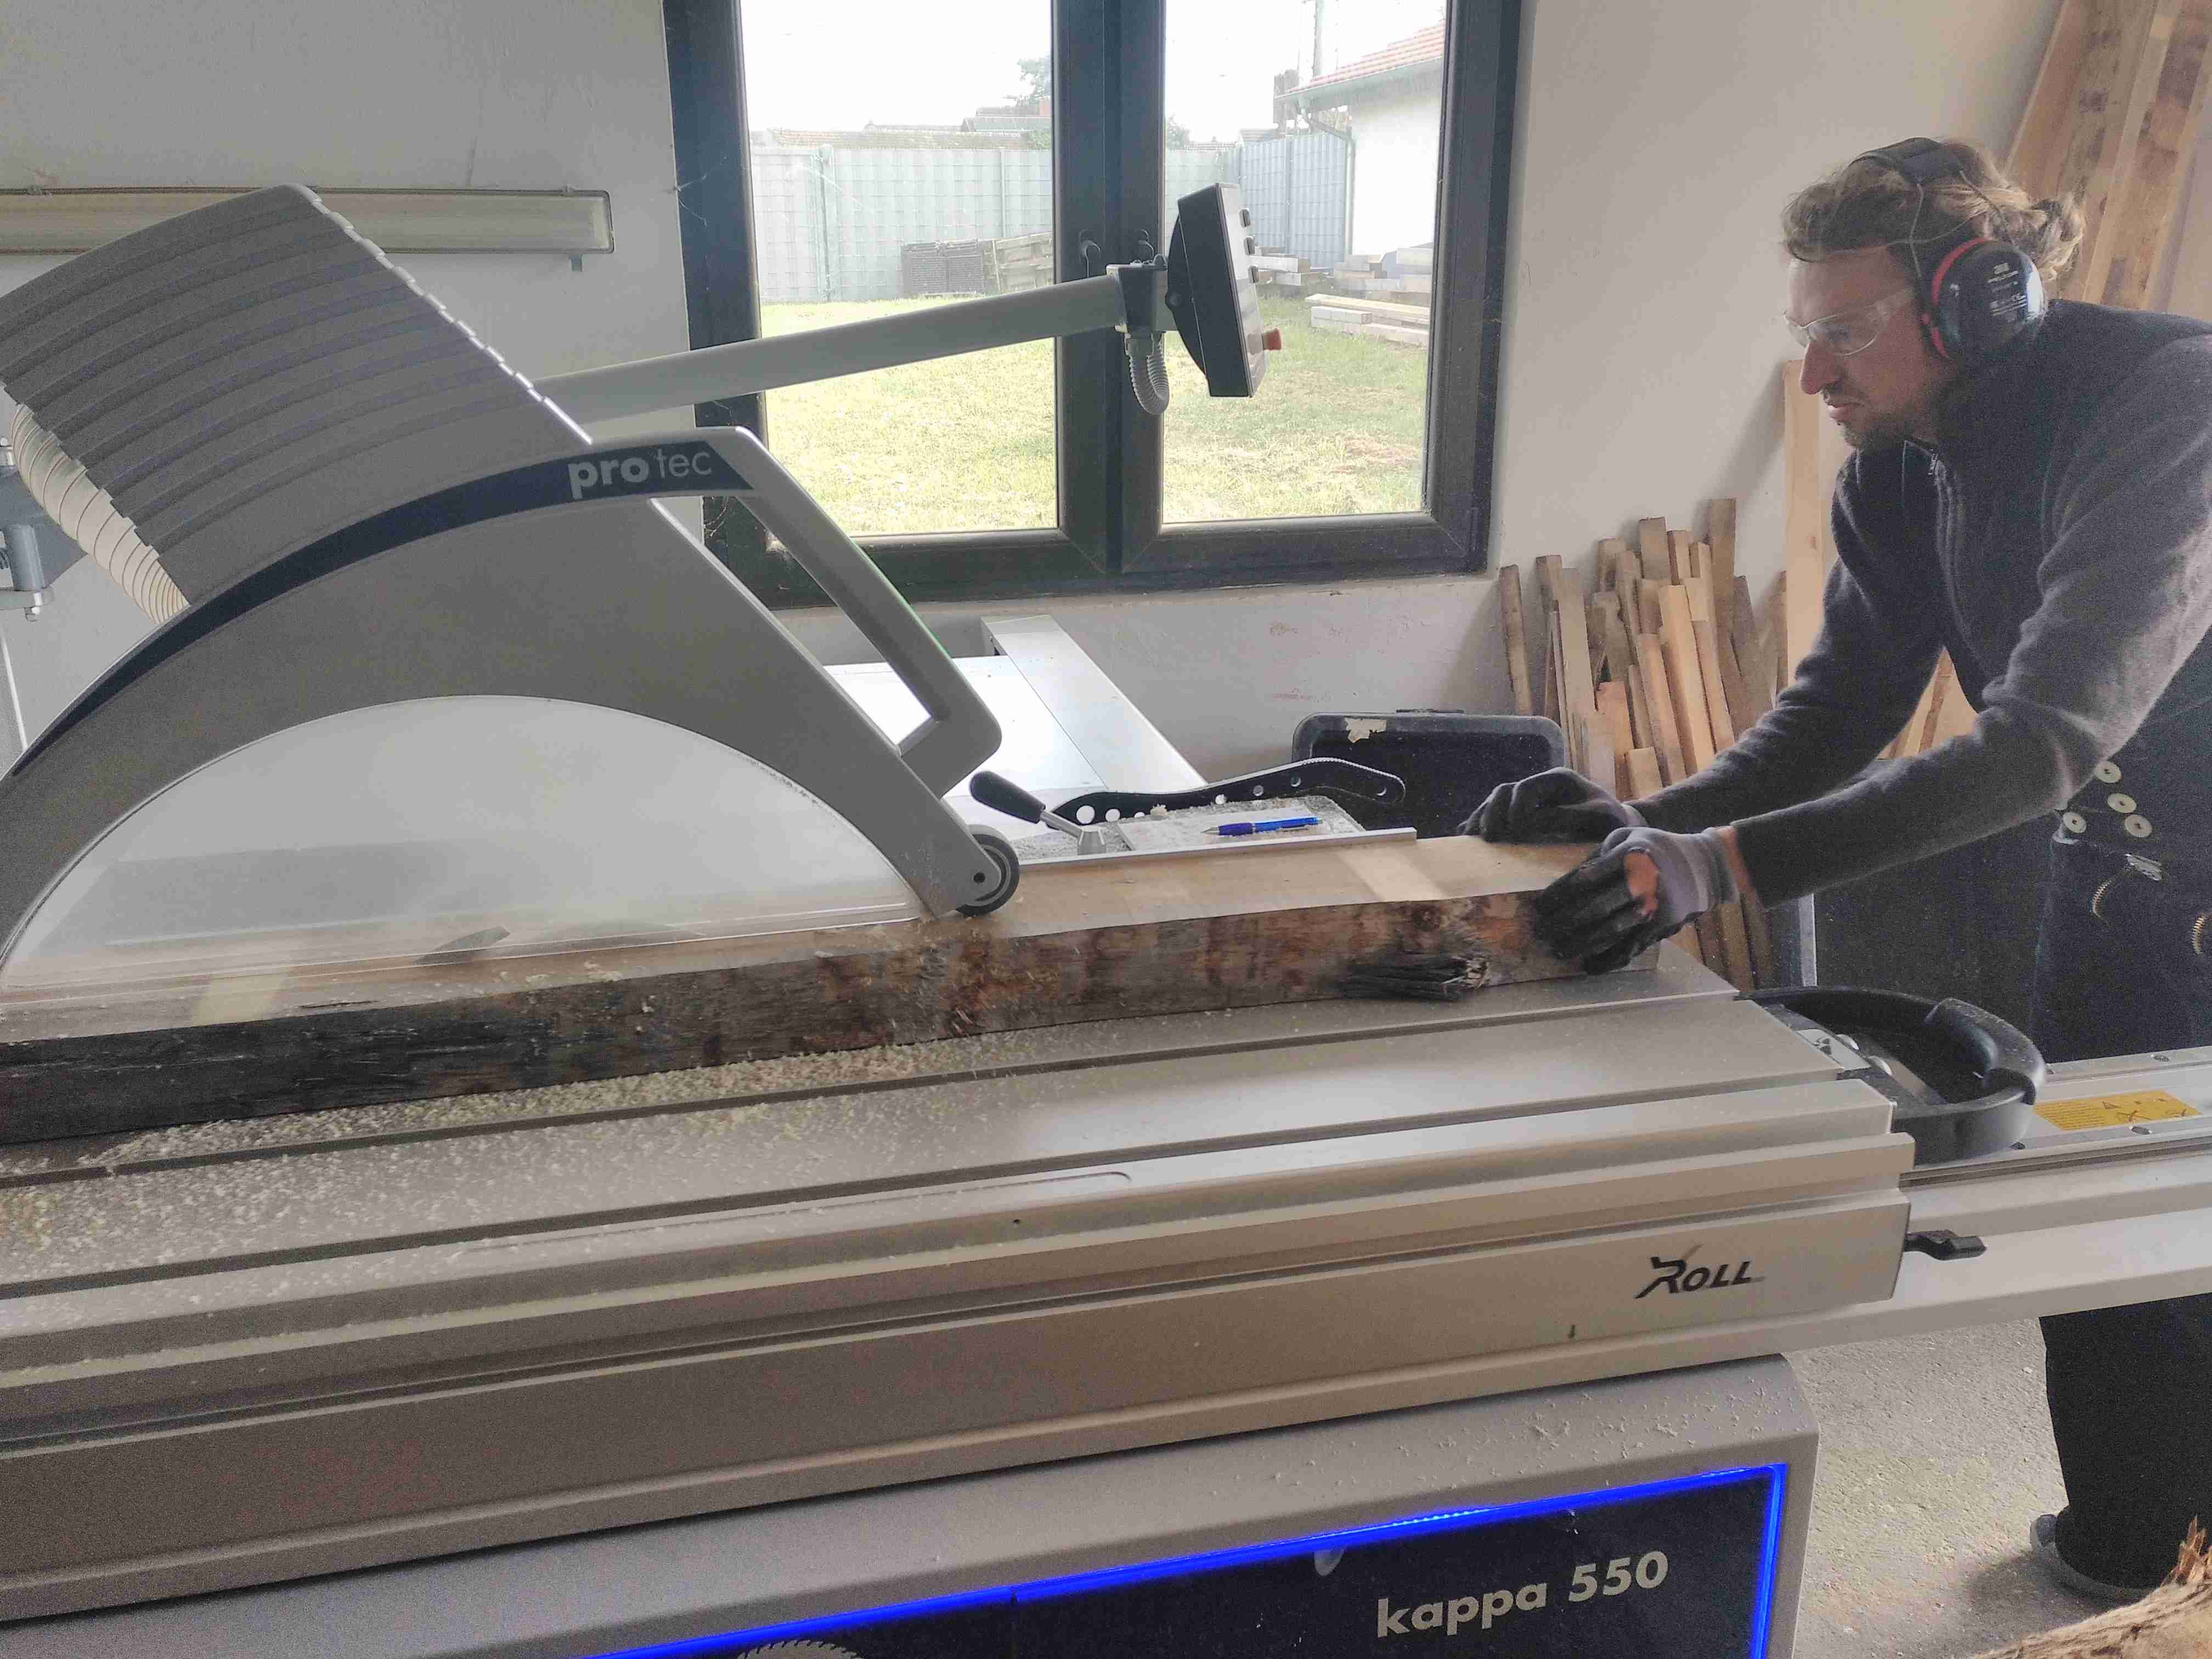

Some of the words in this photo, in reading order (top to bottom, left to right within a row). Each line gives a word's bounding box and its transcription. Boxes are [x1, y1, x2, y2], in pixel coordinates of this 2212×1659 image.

[1634, 1255, 1756, 1299] ROLL
[1376, 1583, 1547, 1638] kappa
[1568, 1550, 1668, 1601] 550
